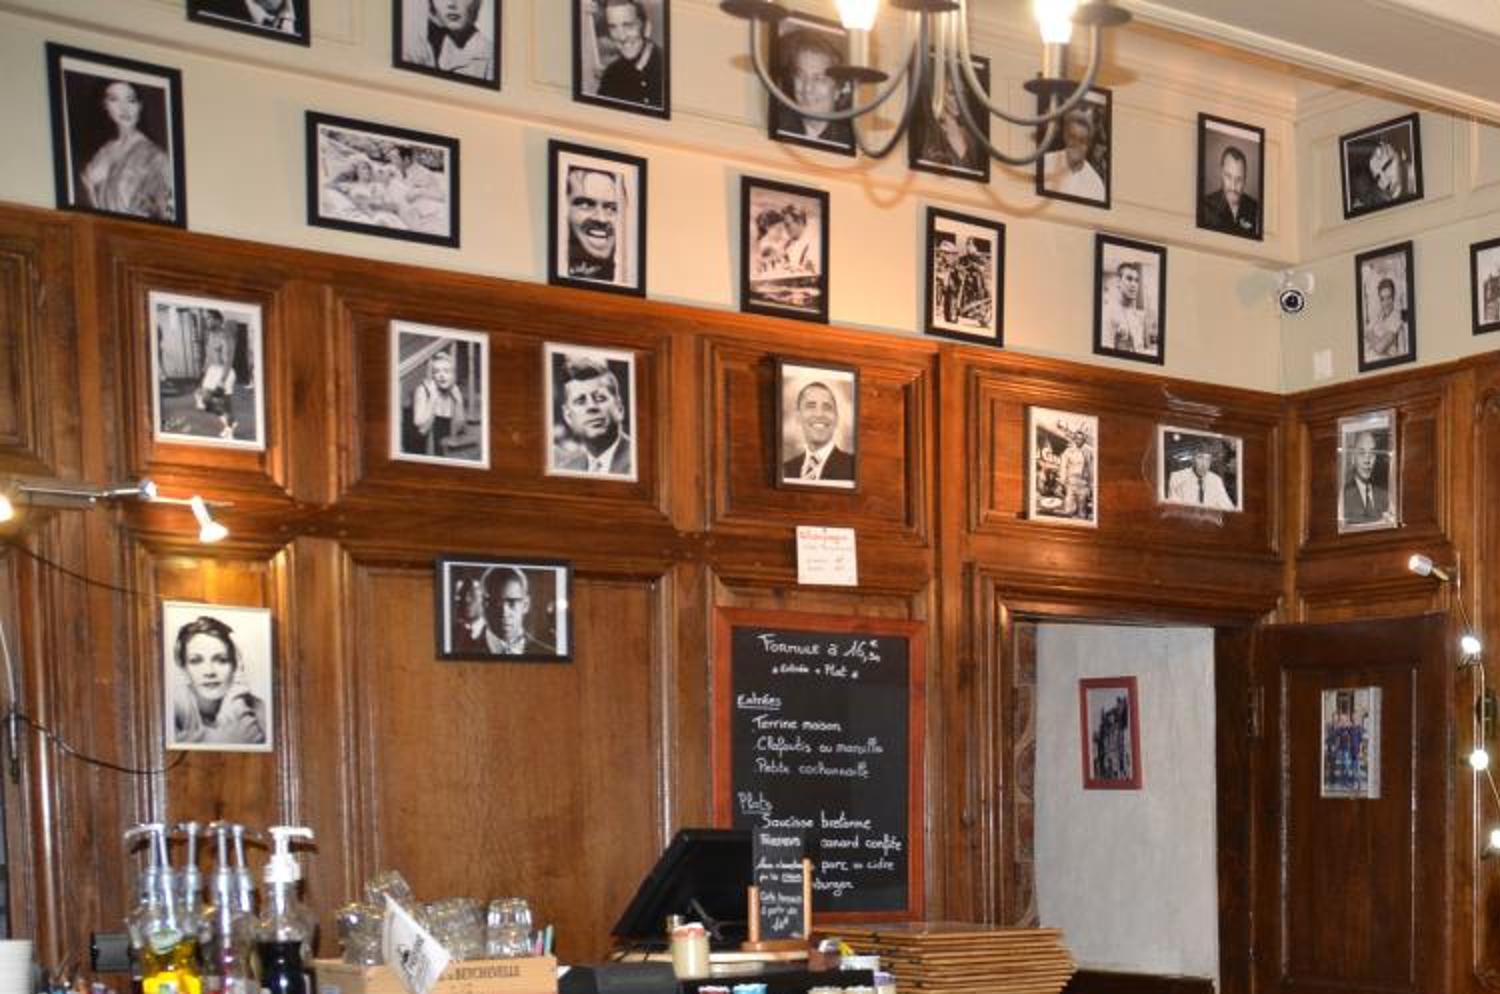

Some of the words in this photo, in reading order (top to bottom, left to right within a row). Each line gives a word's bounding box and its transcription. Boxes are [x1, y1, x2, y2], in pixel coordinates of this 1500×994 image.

[752, 713, 798, 730] Terrine
[801, 719, 842, 732] maison
[761, 813, 815, 829] Saucisse
[812, 877, 855, 897] burger
